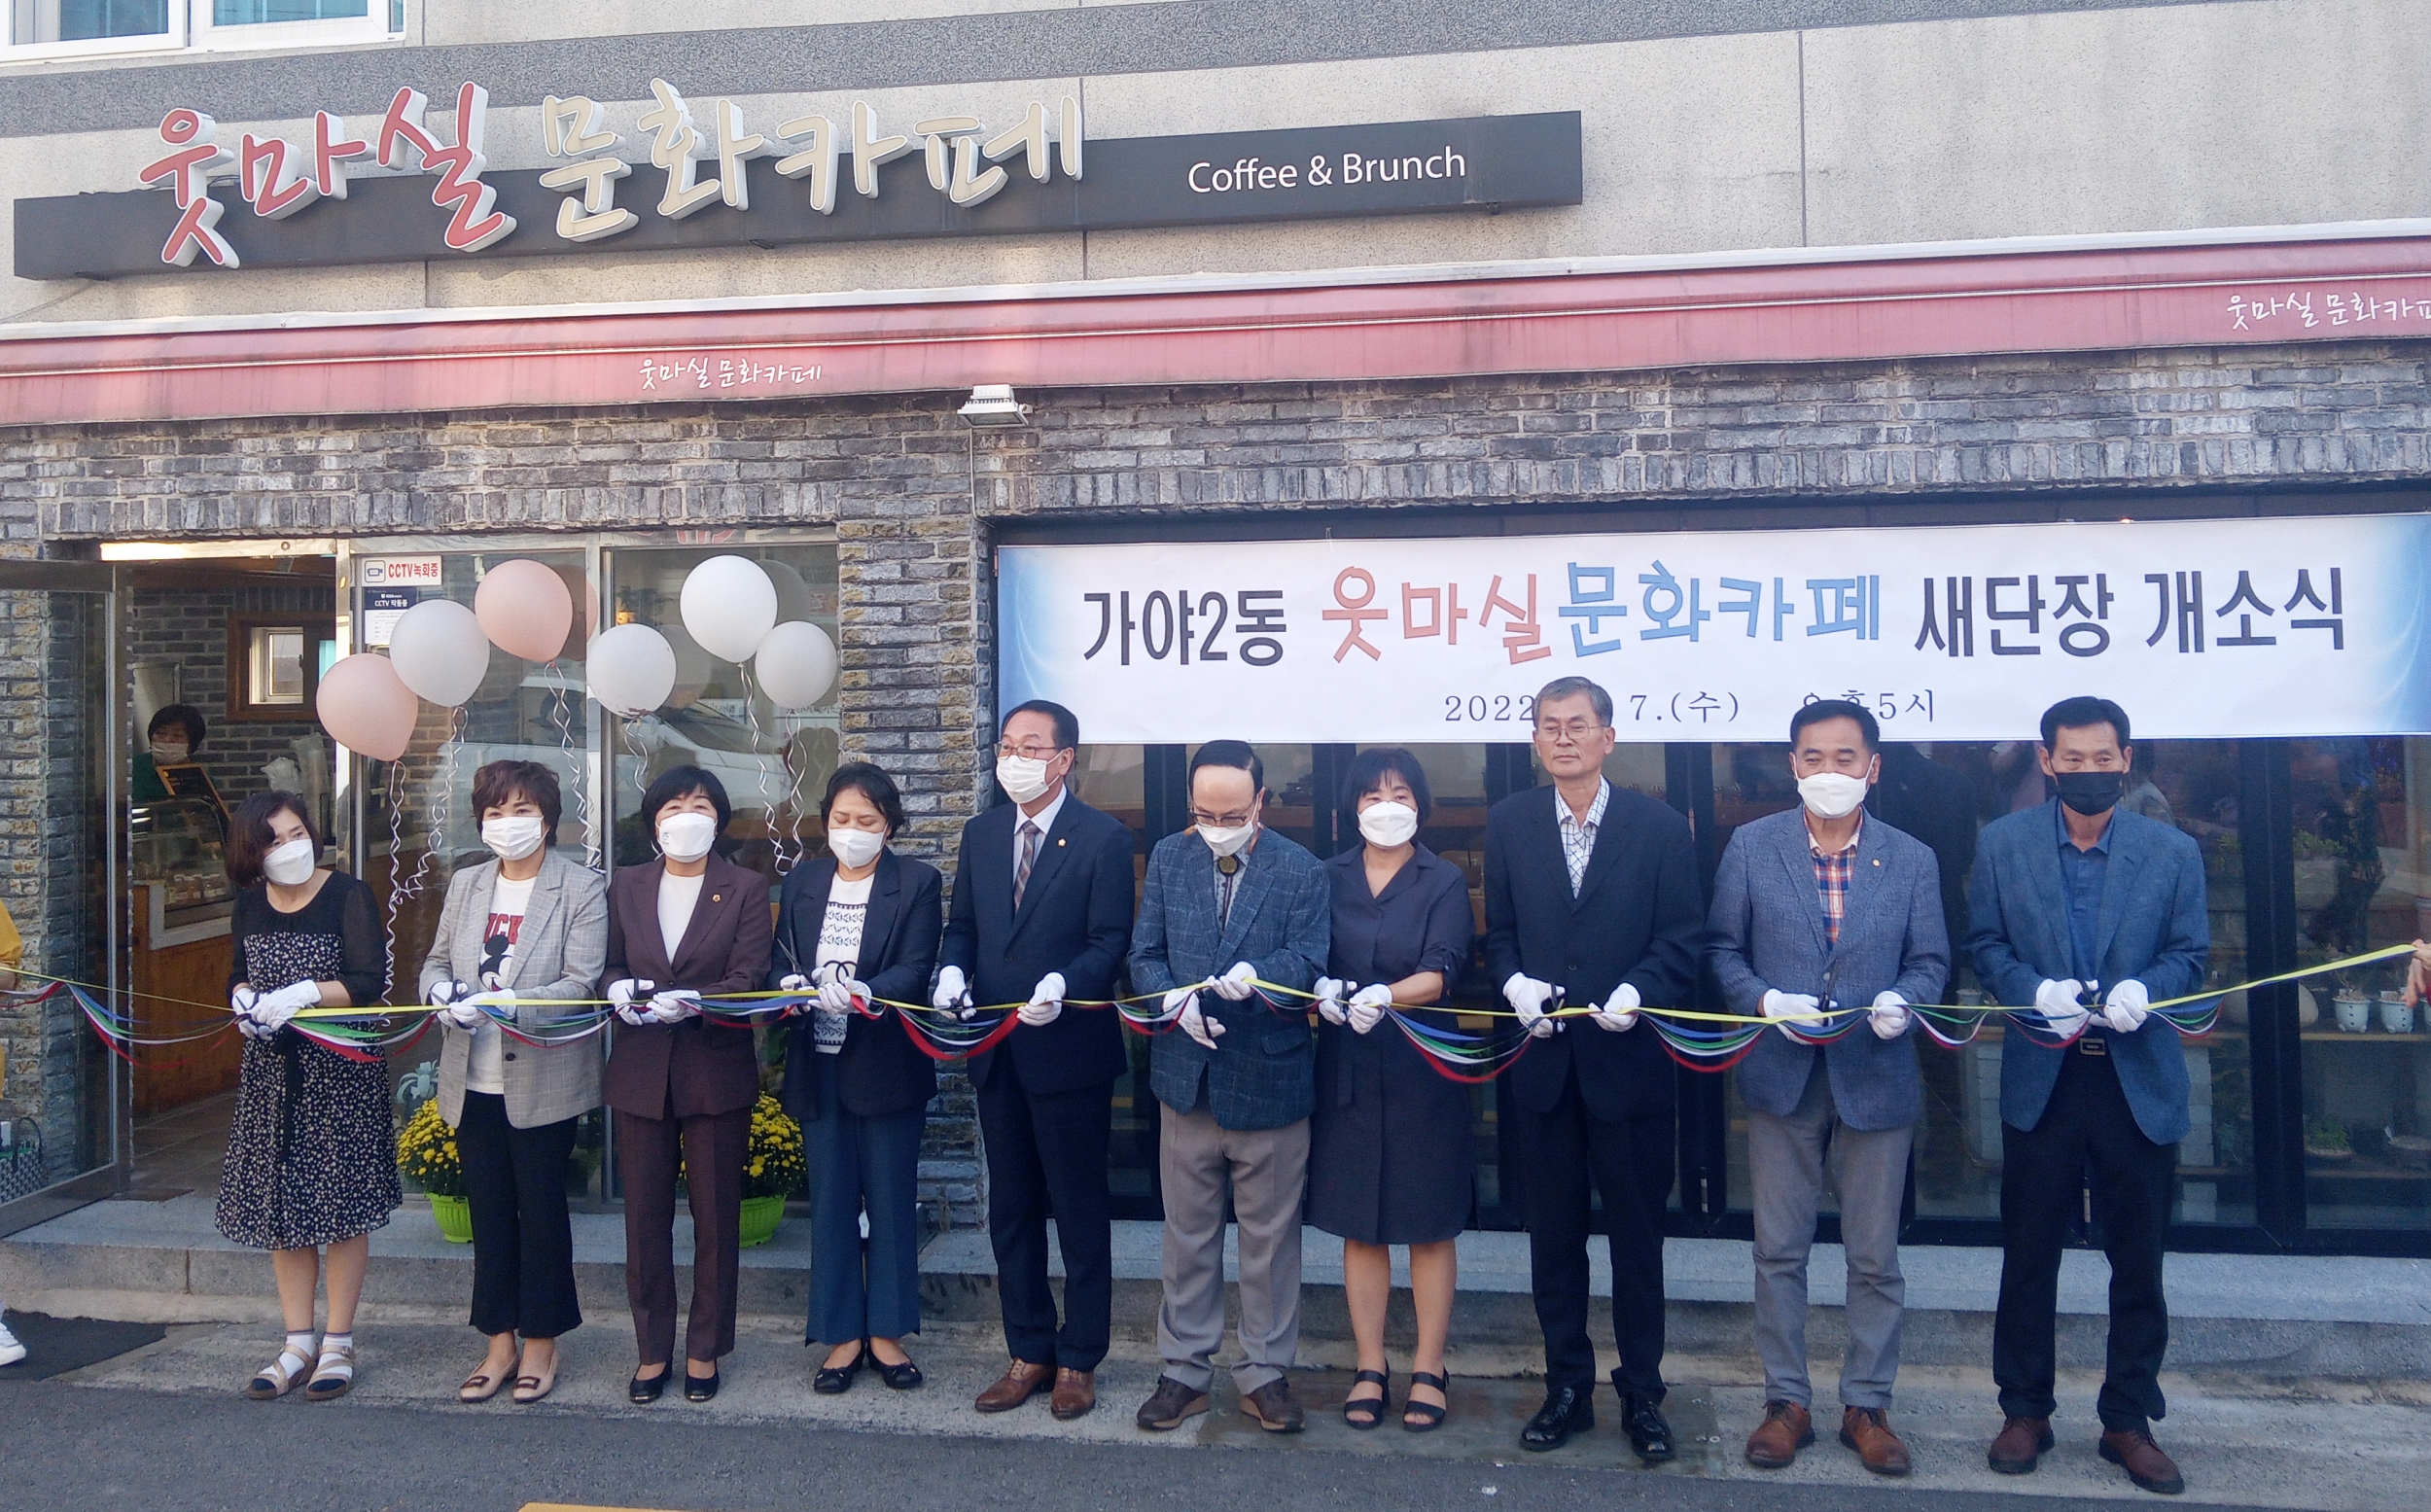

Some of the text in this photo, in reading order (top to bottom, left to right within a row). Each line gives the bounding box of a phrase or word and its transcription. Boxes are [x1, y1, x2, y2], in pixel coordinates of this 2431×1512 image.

[139, 77, 1083, 268] 웃마실 문화카페
[1187, 145, 1466, 193] Coffee & Brunch
[2226, 291, 2320, 331] 웃마실
[639, 356, 823, 391] 웃마실 문화카페
[388, 562, 440, 579] CCTV녹화중
[374, 599, 390, 608] CCTV
[1083, 588, 1287, 667] 가야2동
[1914, 573, 2115, 658] 새단장
[2143, 567, 2345, 652] 개소식
